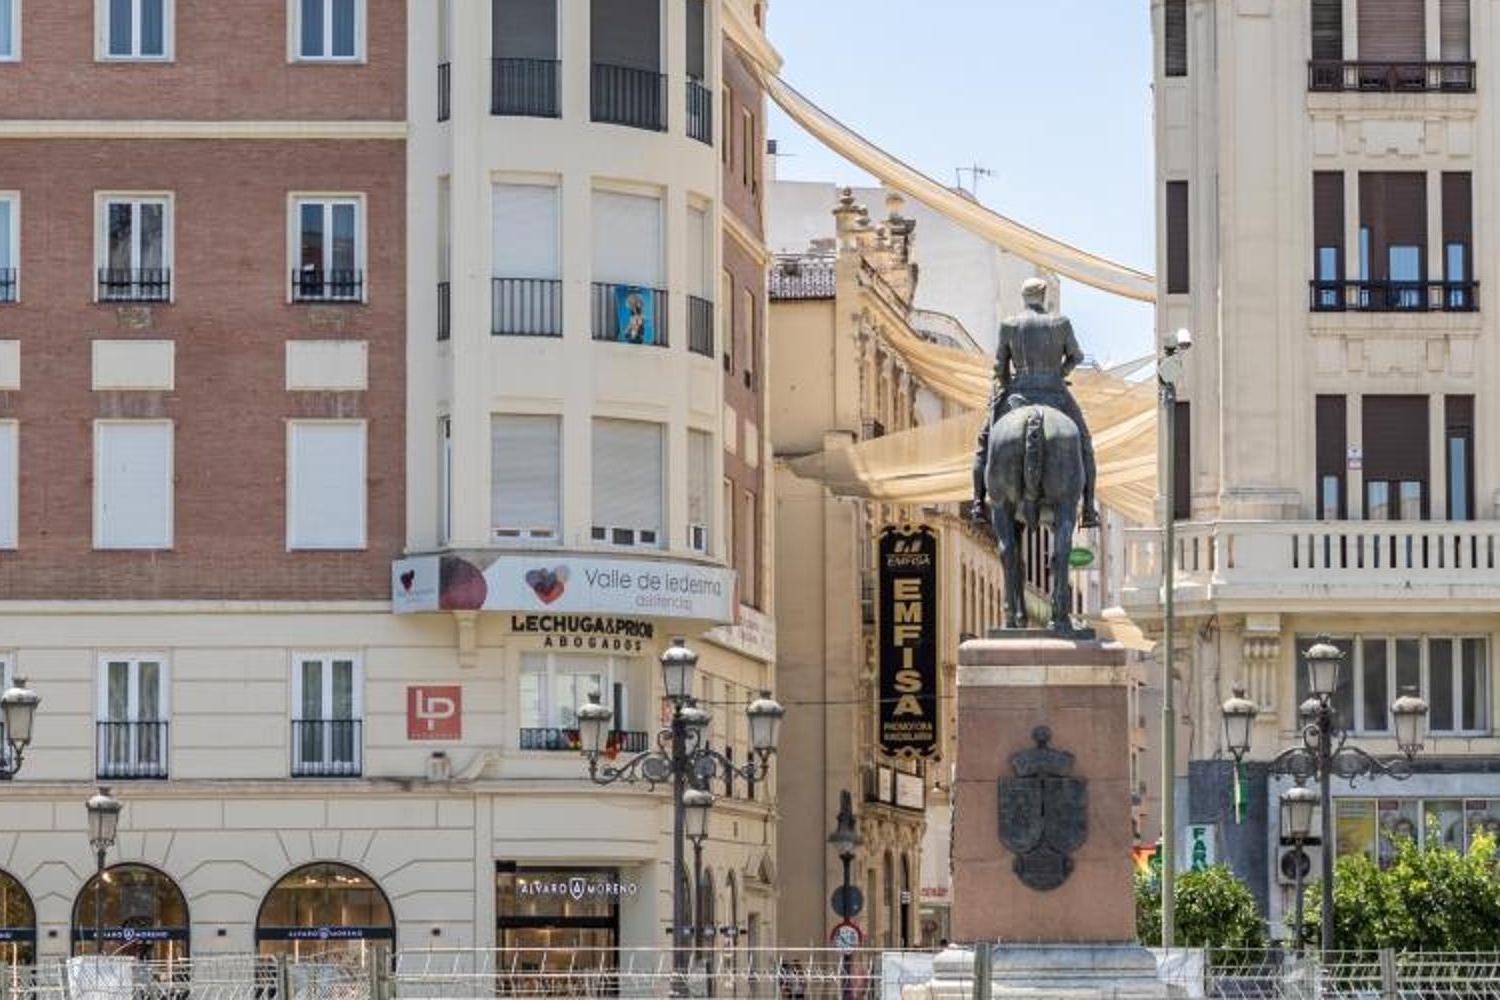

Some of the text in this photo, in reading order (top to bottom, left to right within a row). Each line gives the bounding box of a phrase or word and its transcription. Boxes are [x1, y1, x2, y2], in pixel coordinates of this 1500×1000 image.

[584, 568, 632, 589] Valle
[637, 572, 661, 591] de
[544, 635, 642, 651] ABOGADOS
[893, 578, 923, 716] EMFISA
[587, 883, 637, 895] MORENO
